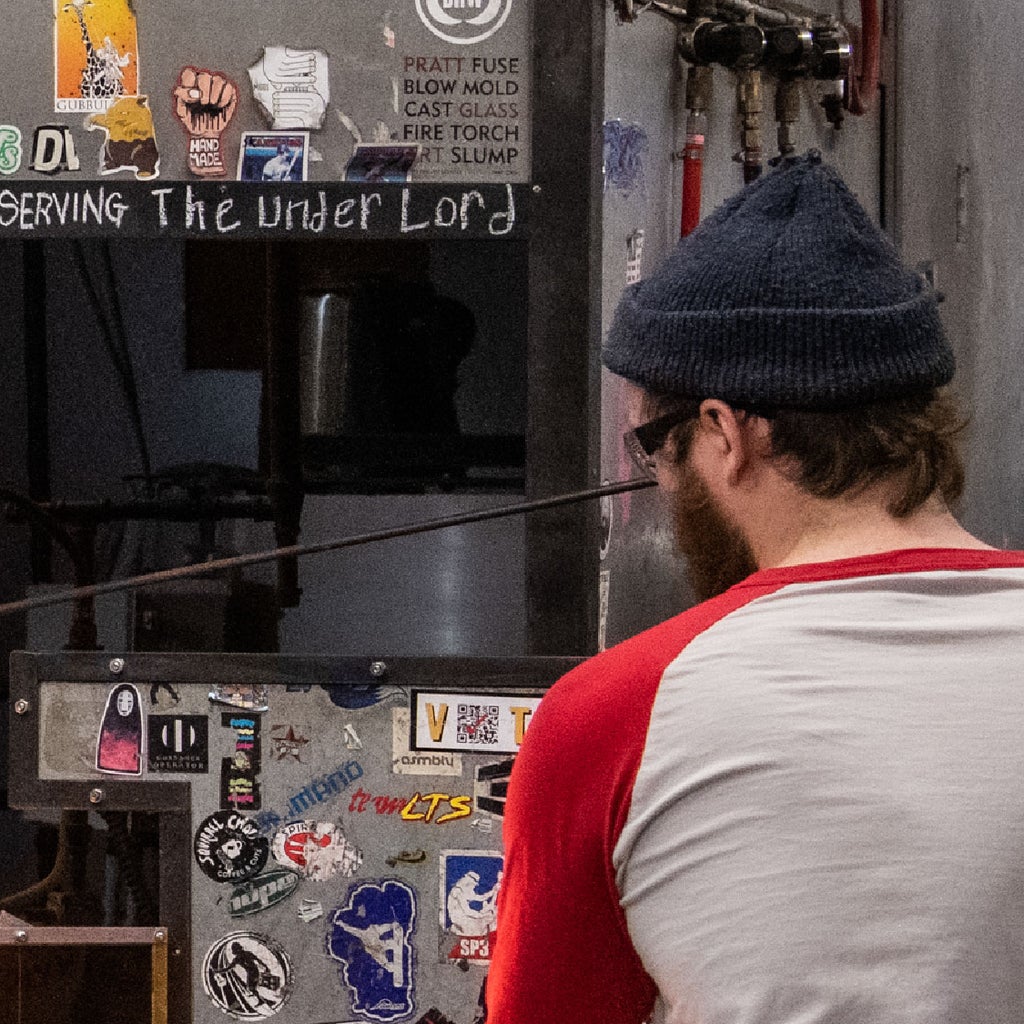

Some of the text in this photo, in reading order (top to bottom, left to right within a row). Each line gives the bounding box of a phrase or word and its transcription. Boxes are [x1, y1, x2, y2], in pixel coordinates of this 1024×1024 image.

[404, 57, 519, 73] PRATT FUSE
[404, 79, 519, 95] BLOW MOLD
[405, 101, 519, 118] CAST GLASS
[404, 125, 519, 141] FIRE TORCH
[190, 139, 219, 152] HAND
[189, 153, 222, 167] MADE
[417, 147, 519, 163] RT SLUMP
[152, 186, 240, 233] The
[400, 184, 516, 236] Lord
[401, 755, 454, 767] asmbly
[401, 792, 473, 824] LTS
